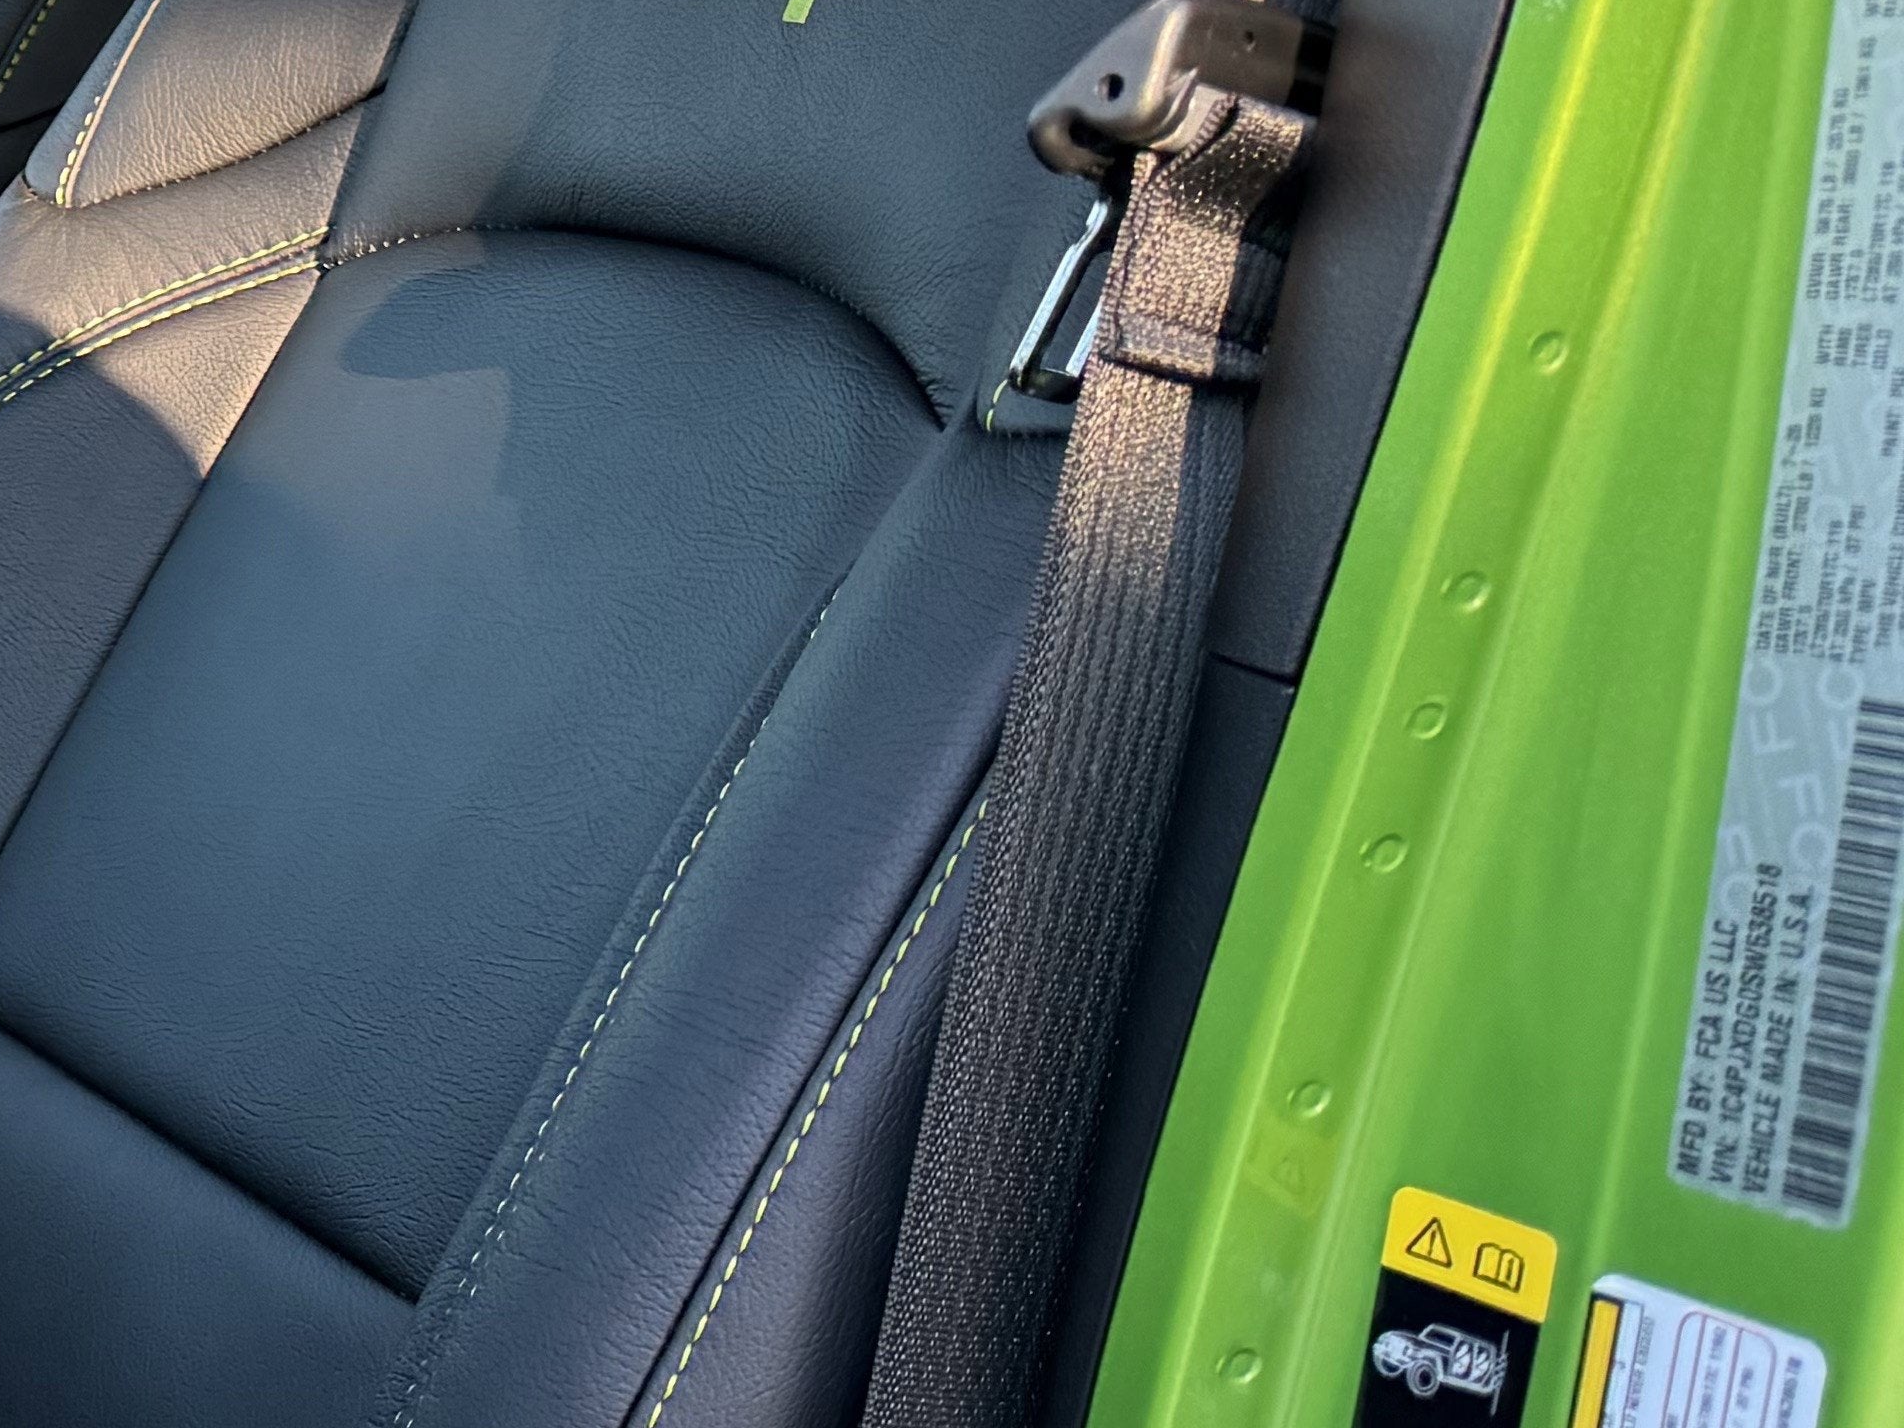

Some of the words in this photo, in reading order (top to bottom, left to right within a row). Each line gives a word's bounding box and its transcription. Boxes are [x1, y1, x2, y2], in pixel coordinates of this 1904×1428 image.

[1711, 917, 1738, 964] LLC
[1704, 970, 1729, 1006] US
[1695, 1012, 1723, 1061] FCA
[1759, 1010, 1792, 1086] MADE
[1686, 1070, 1713, 1112] BY:
[1675, 1118, 1705, 1176] MFD
[1707, 1134, 1738, 1185] VIN:
[1741, 1090, 1779, 1195] VEHICLE
